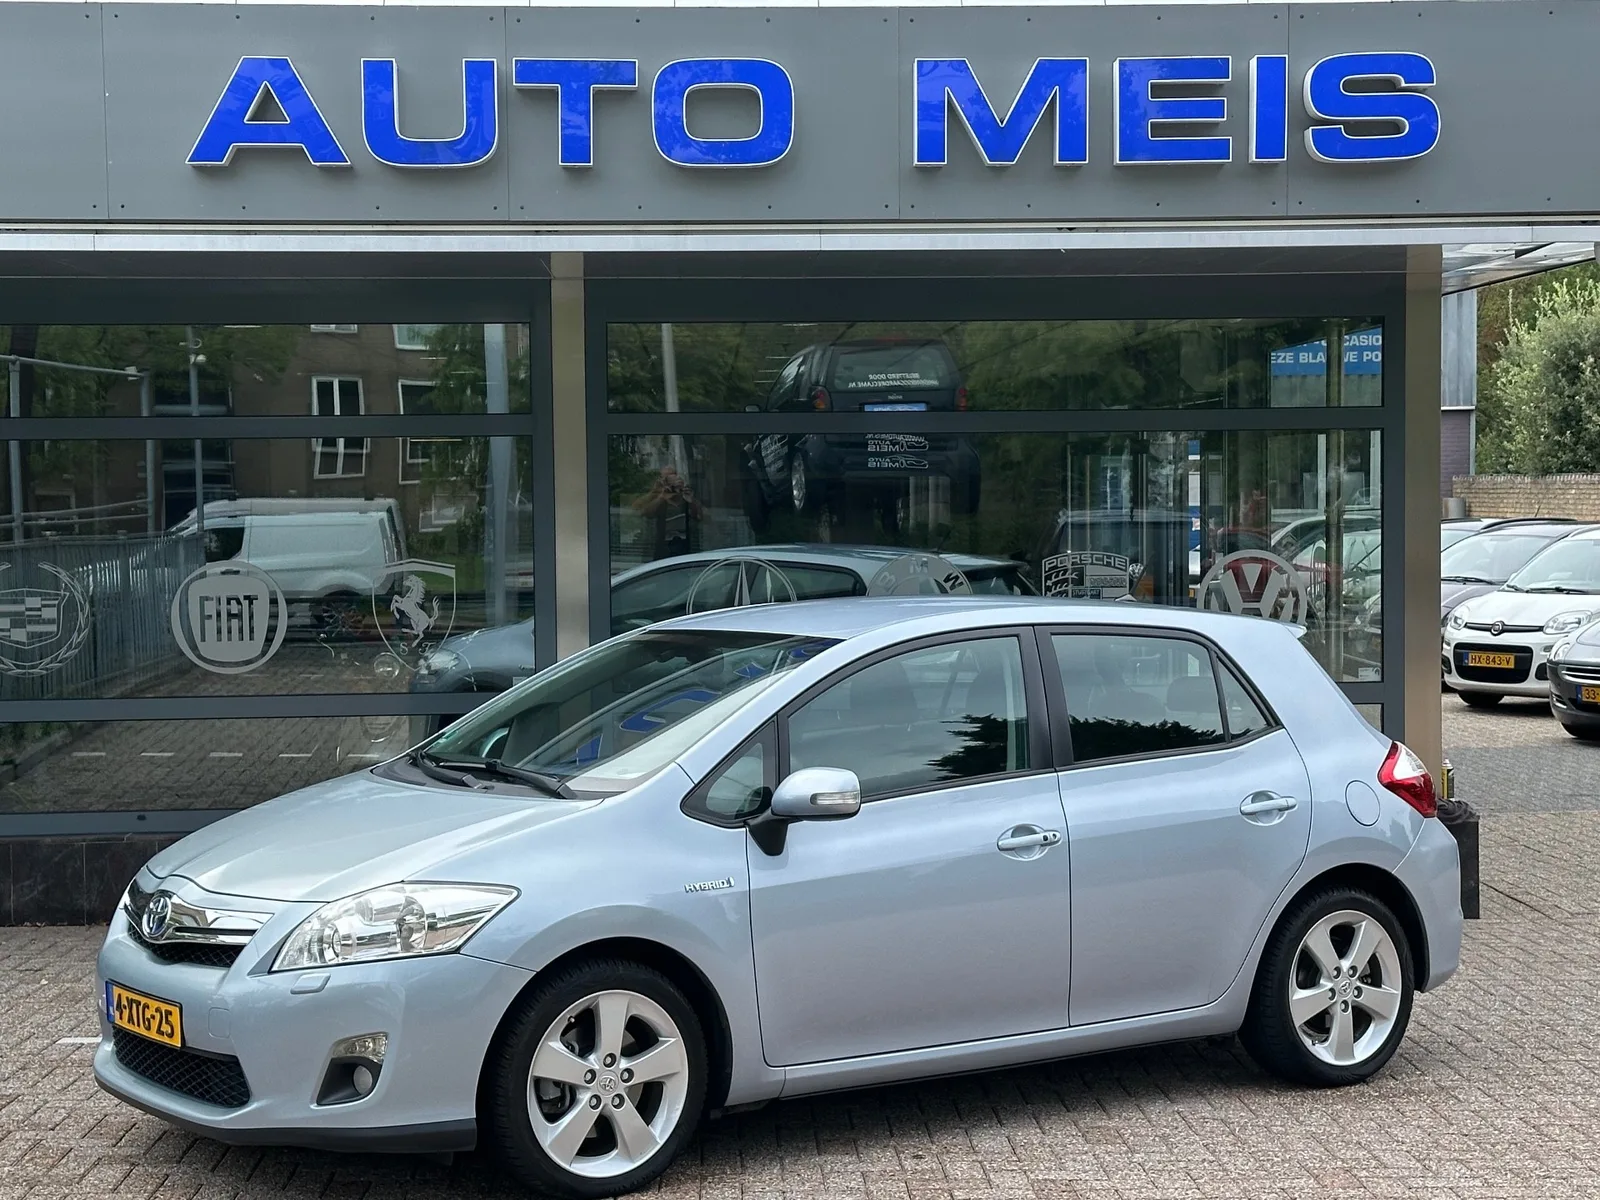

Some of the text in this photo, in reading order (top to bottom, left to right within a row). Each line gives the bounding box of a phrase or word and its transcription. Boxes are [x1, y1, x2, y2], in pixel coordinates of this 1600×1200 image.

[185, 51, 1442, 168] AUTO MEIS
[1045, 554, 1127, 572] PORSCHE
[199, 595, 258, 642] FIAT
[1470, 653, 1512, 666] HX-843-V
[684, 879, 729, 893] HYBRID
[115, 992, 175, 1039] 4-XTG-25
